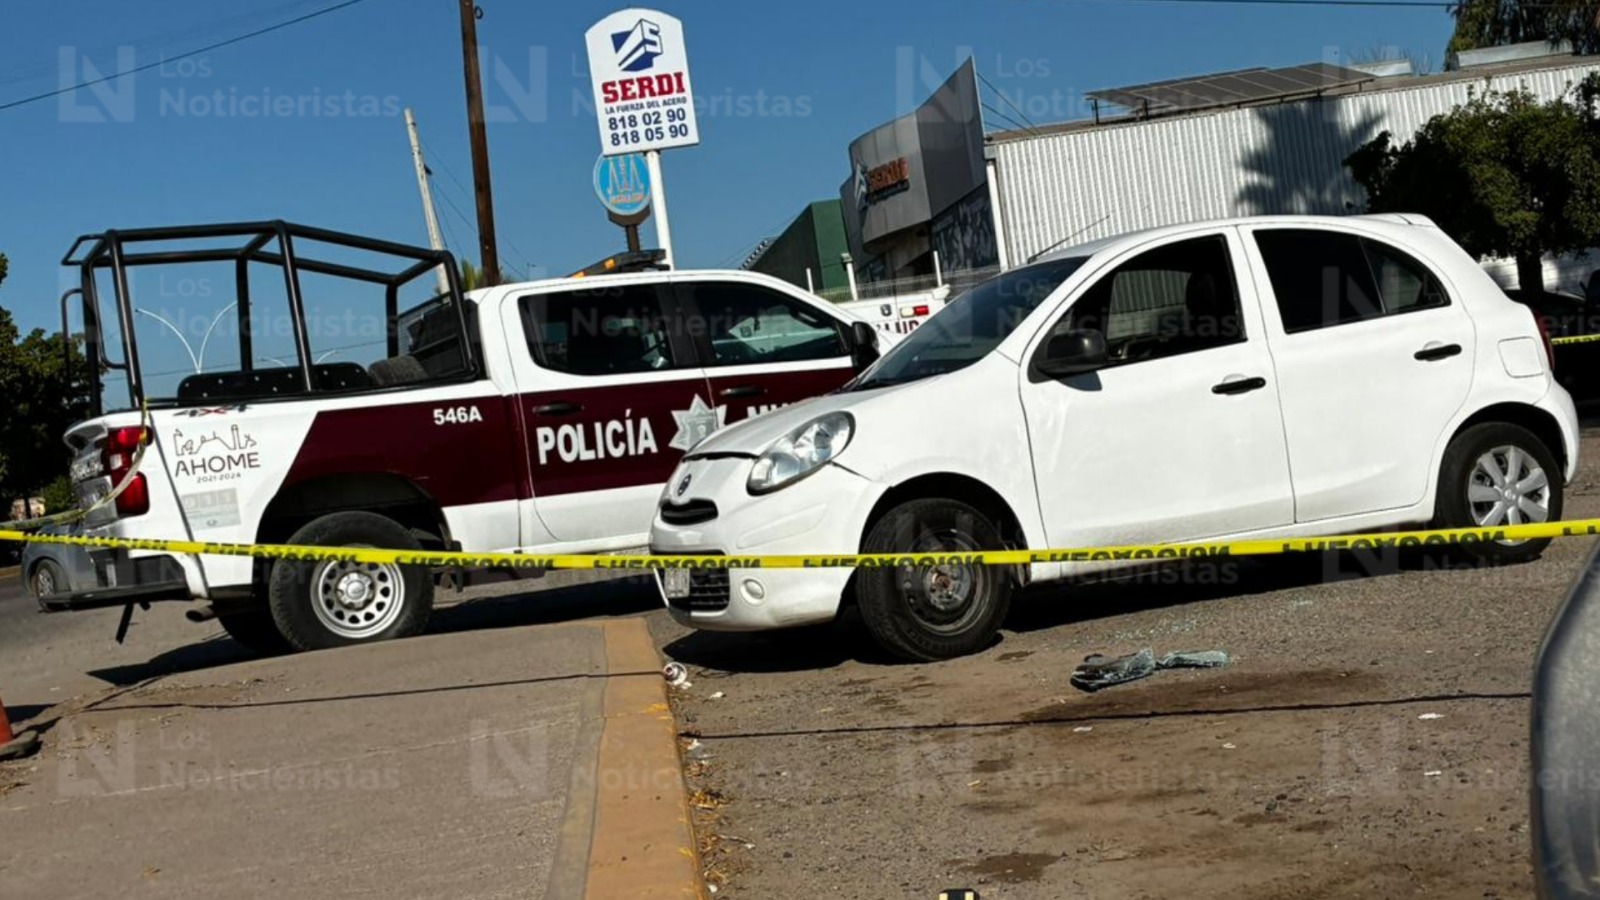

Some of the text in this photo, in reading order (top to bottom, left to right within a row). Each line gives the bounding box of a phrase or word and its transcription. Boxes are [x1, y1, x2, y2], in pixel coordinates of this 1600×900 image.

[602, 72, 685, 104] SERDI
[605, 96, 687, 115] LA FUERZA DEL ACERO
[608, 108, 686, 131] 818 02 90
[611, 123, 688, 146] 818 05 90
[433, 406, 483, 425] 546A
[536, 409, 659, 465] POLICÍA
[175, 452, 261, 477] AHOME
